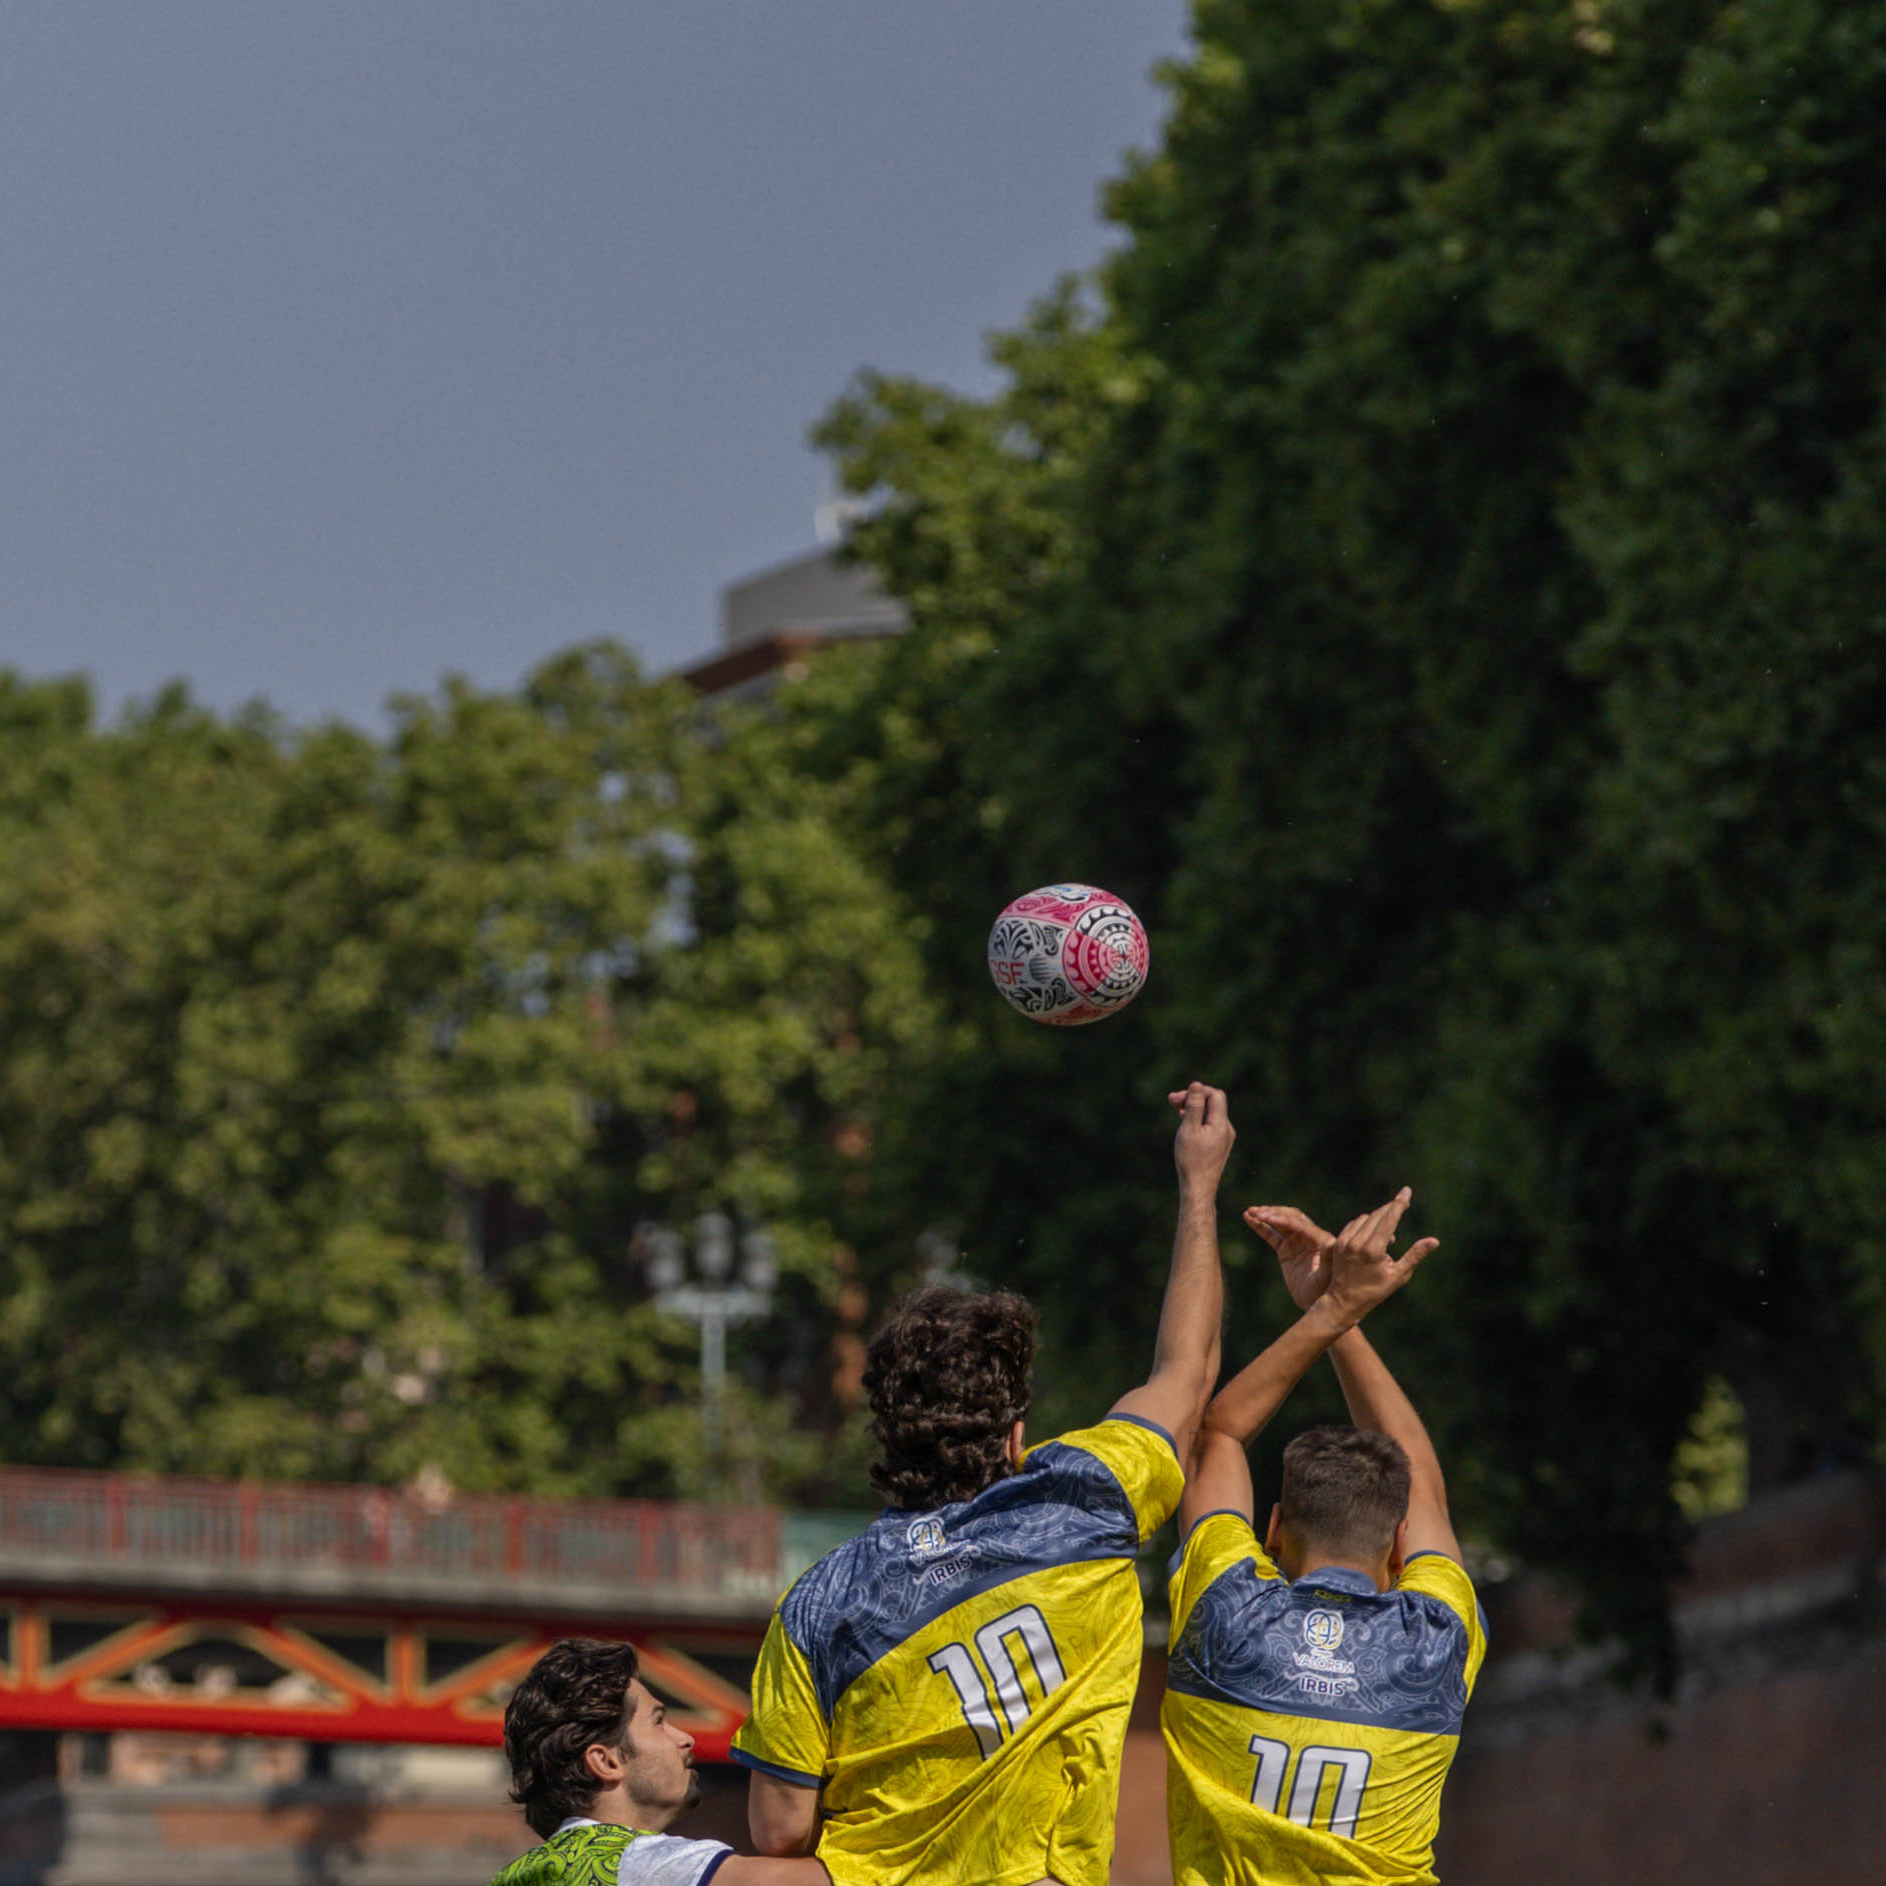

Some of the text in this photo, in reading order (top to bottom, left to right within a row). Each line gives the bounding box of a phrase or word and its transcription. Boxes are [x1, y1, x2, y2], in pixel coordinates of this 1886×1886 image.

[930, 1555, 971, 1584] IRBIS
[926, 1603, 1067, 1762] 10
[1300, 1677, 1344, 1696] IRBIS
[1248, 1734, 1372, 1840] 10
